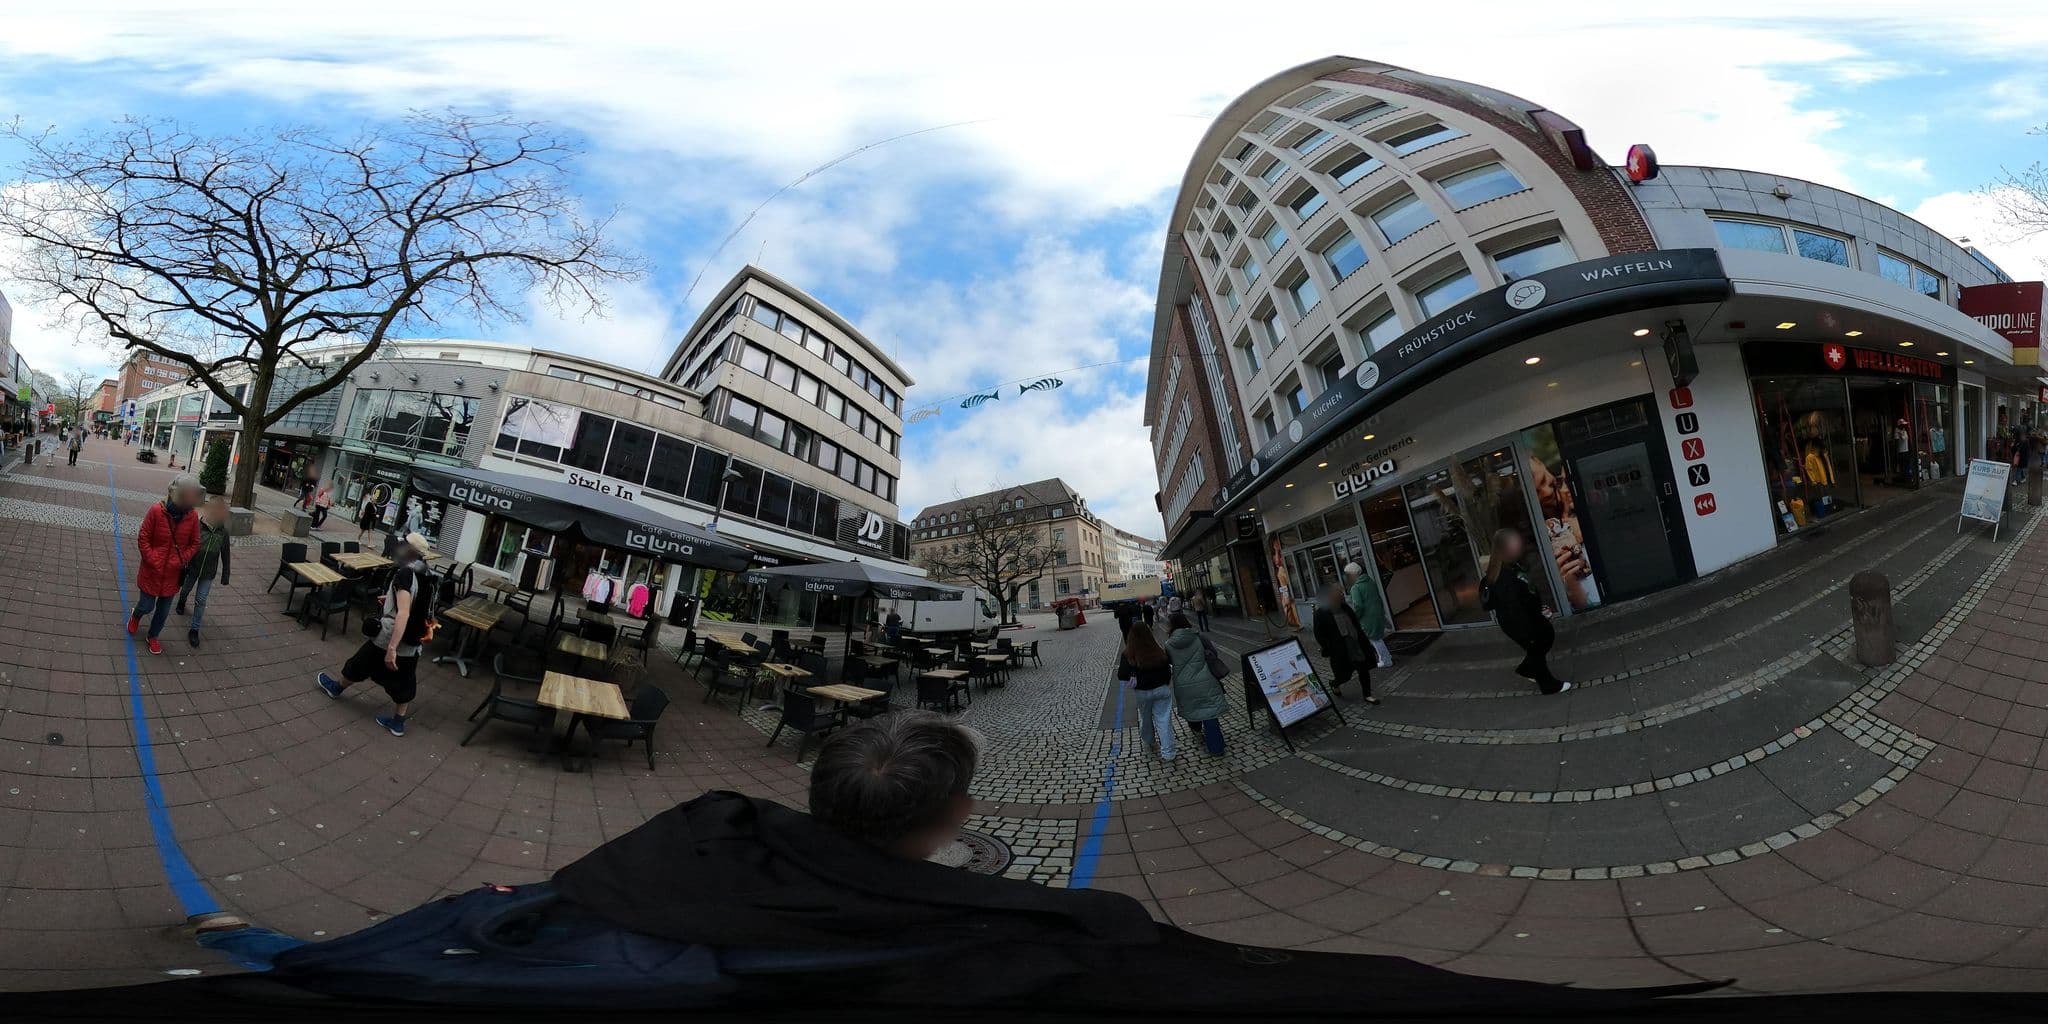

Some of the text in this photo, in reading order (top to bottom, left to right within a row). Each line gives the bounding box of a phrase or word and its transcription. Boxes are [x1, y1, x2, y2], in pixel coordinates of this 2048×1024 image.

[1581, 259, 1674, 282] WAFFELN
[1397, 310, 1477, 358] FRÜHSTÜCK
[1853, 348, 1943, 378] WELLENSTEYN
[1311, 391, 1344, 421] KUCHEN
[568, 472, 634, 501] Style In
[857, 511, 884, 540] JD
